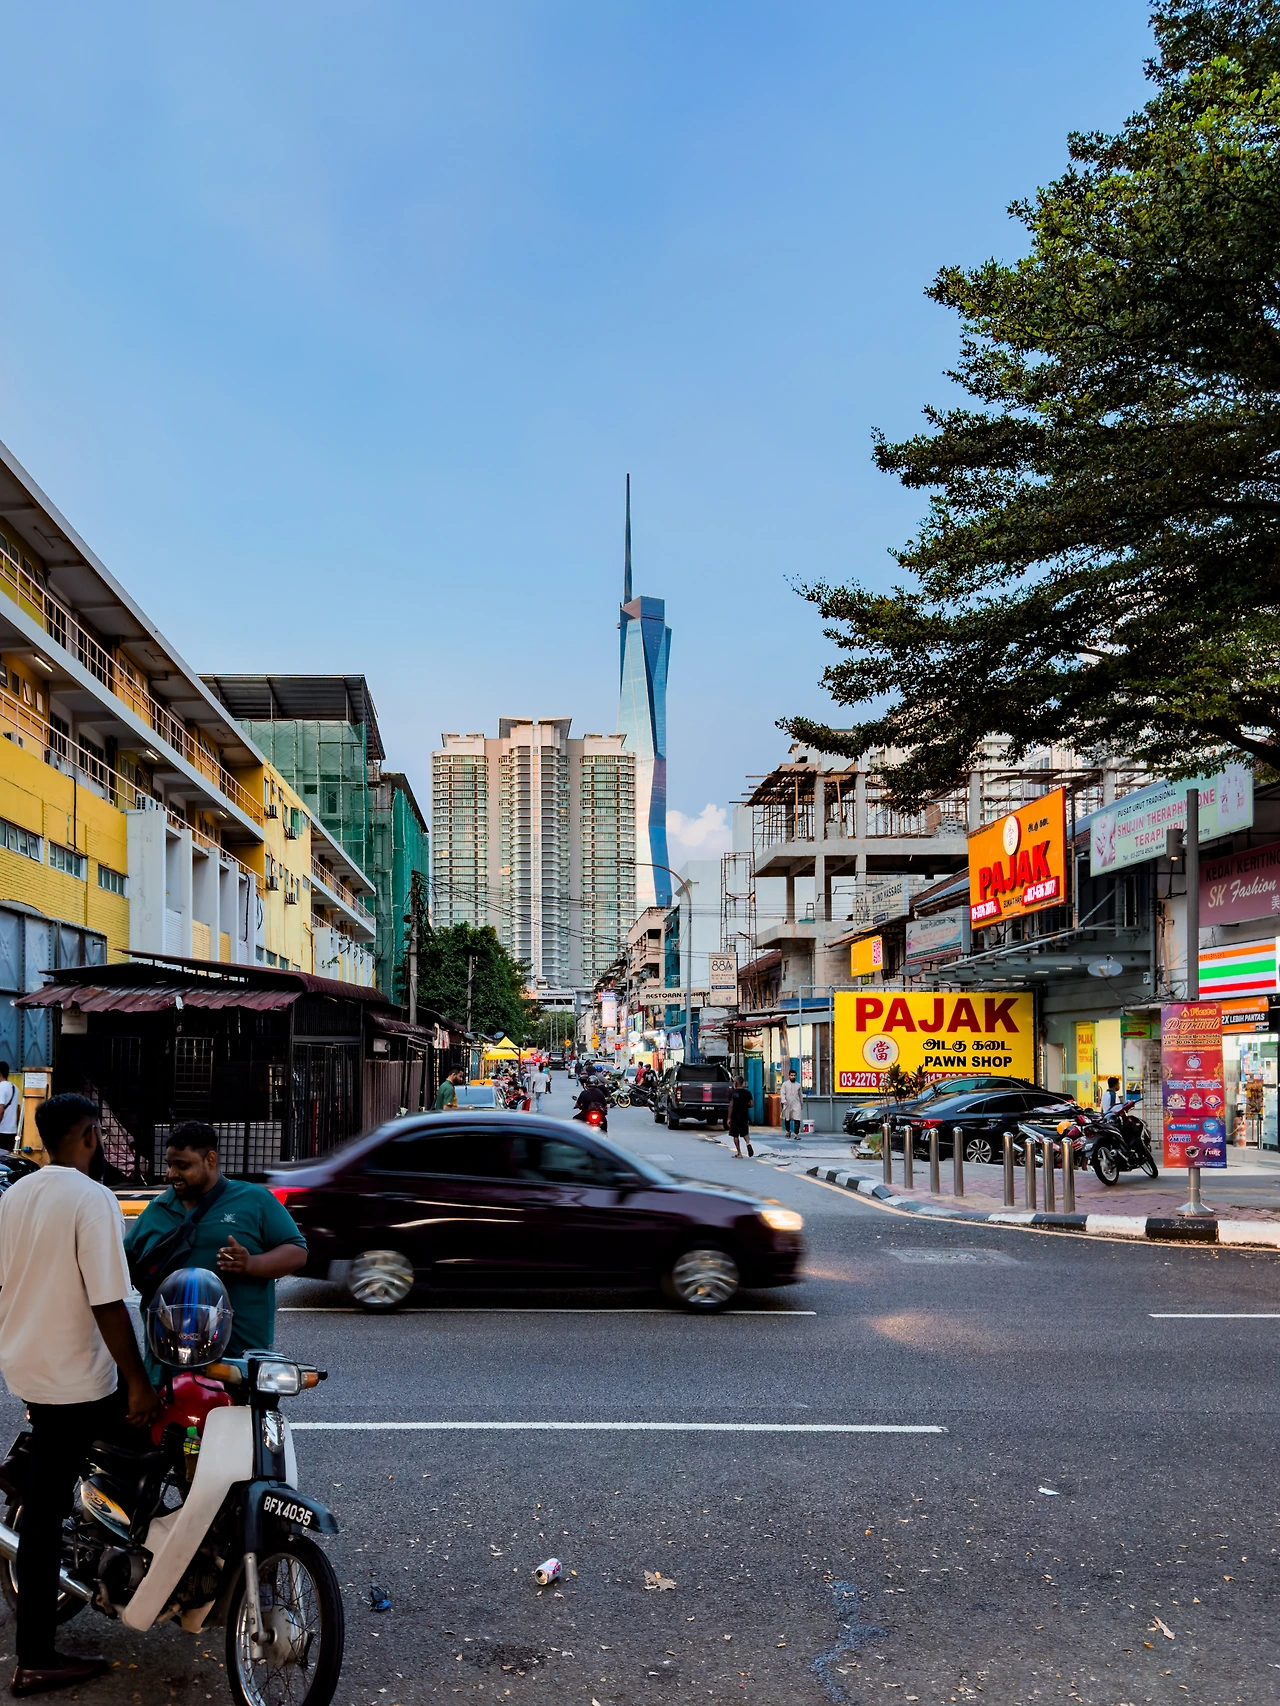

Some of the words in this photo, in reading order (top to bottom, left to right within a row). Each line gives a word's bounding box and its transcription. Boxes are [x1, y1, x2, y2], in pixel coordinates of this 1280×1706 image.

[1117, 806, 1132, 818] PUSAT
[1132, 800, 1145, 812] URUT
[1146, 788, 1177, 807] TRADISIONAL
[1117, 816, 1144, 838] SHUJIN
[1146, 799, 1188, 826] THERAPHY
[1134, 827, 1164, 848] TERAPI
[979, 840, 1051, 901] PAJAK
[1206, 864, 1233, 882] KEDAI
[884, 883, 903, 899] MASSAGE
[1208, 884, 1227, 909] SK
[1230, 876, 1277, 903] Fashion
[856, 998, 1020, 1033] PAJAK
[1230, 1014, 1245, 1023] LEBIH
[1244, 1012, 1266, 1022] PANTAS
[872, 1041, 889, 1061] 當
[922, 1038, 967, 1053] அடகு
[972, 1039, 1012, 1051] கடை
[924, 1056, 967, 1067] PAWN
[971, 1055, 1012, 1068] SHOP
[841, 1073, 877, 1086] 03-2276
[263, 1496, 313, 1526] BFX4035
